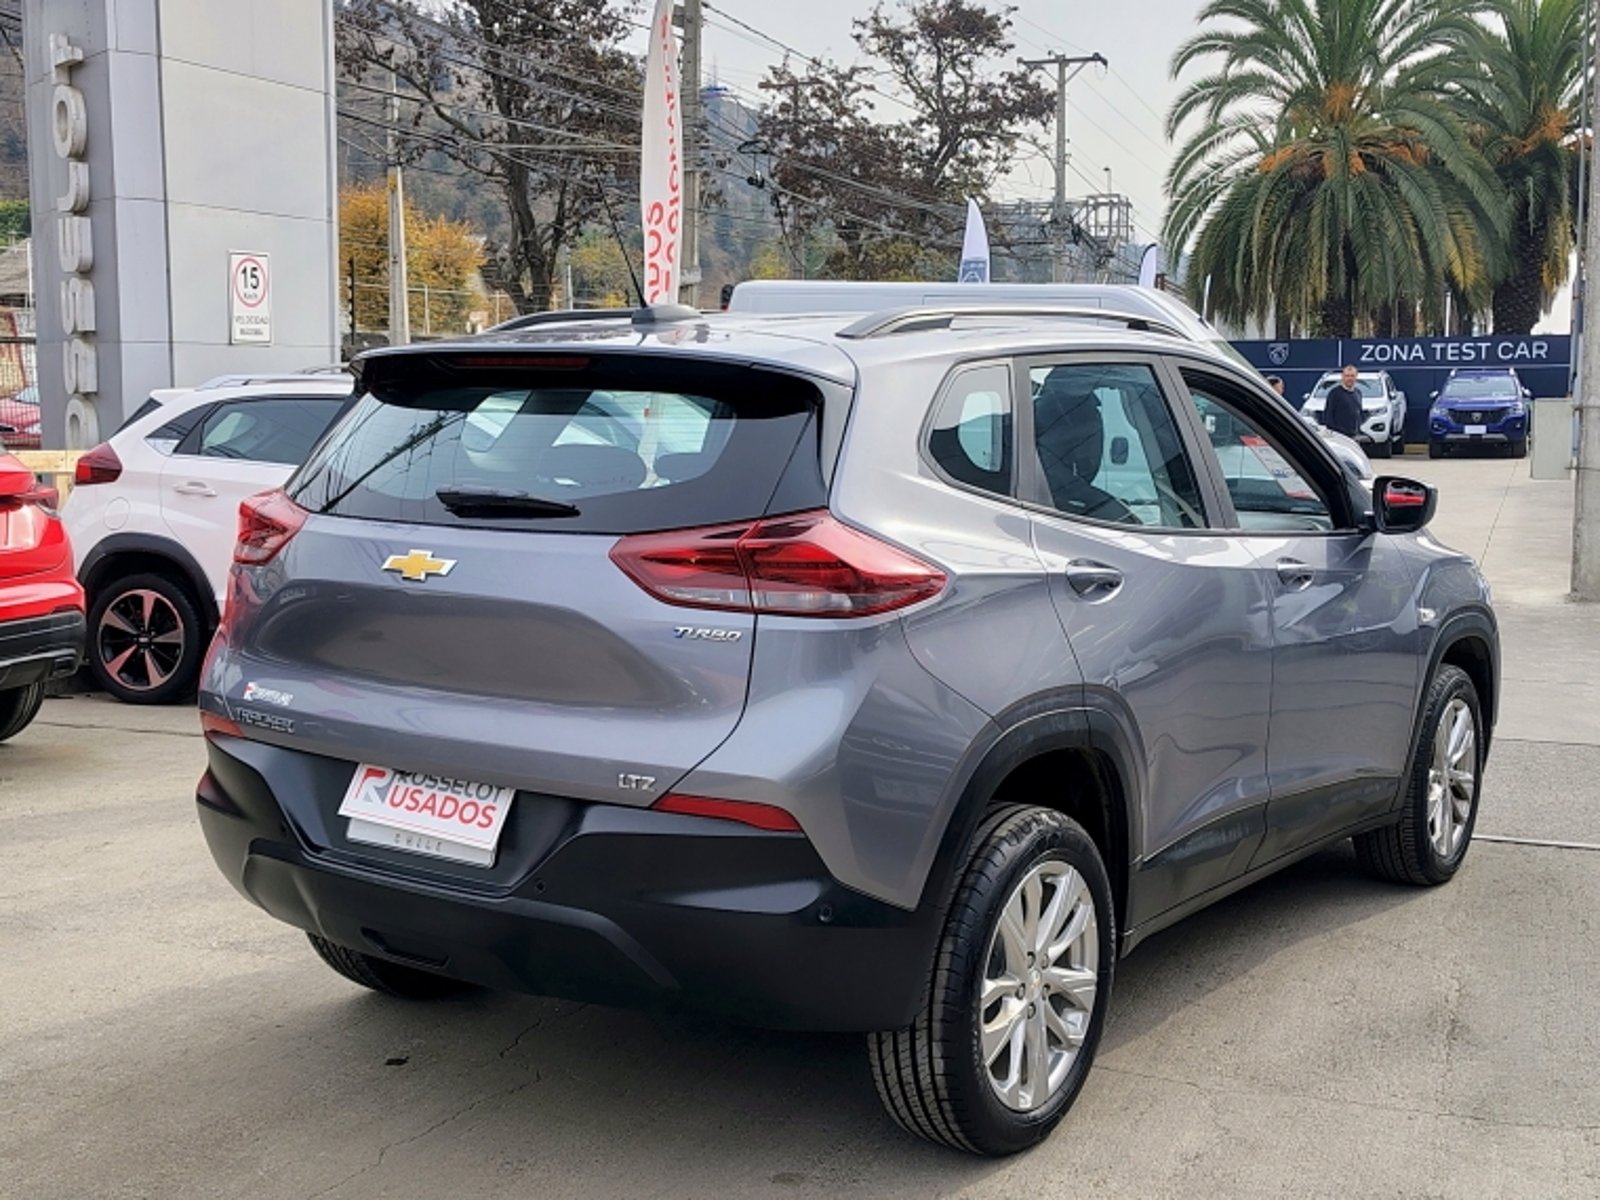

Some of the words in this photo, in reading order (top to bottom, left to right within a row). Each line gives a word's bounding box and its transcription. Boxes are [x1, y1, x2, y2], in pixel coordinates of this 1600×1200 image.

[240, 266, 260, 290] 15
[1360, 344, 1426, 362] ZONA
[1431, 342, 1491, 361] TEST
[1497, 341, 1549, 359] CAR
[674, 626, 742, 642] TURBO
[617, 772, 657, 792] LTZ
[389, 784, 497, 829] USADOS
